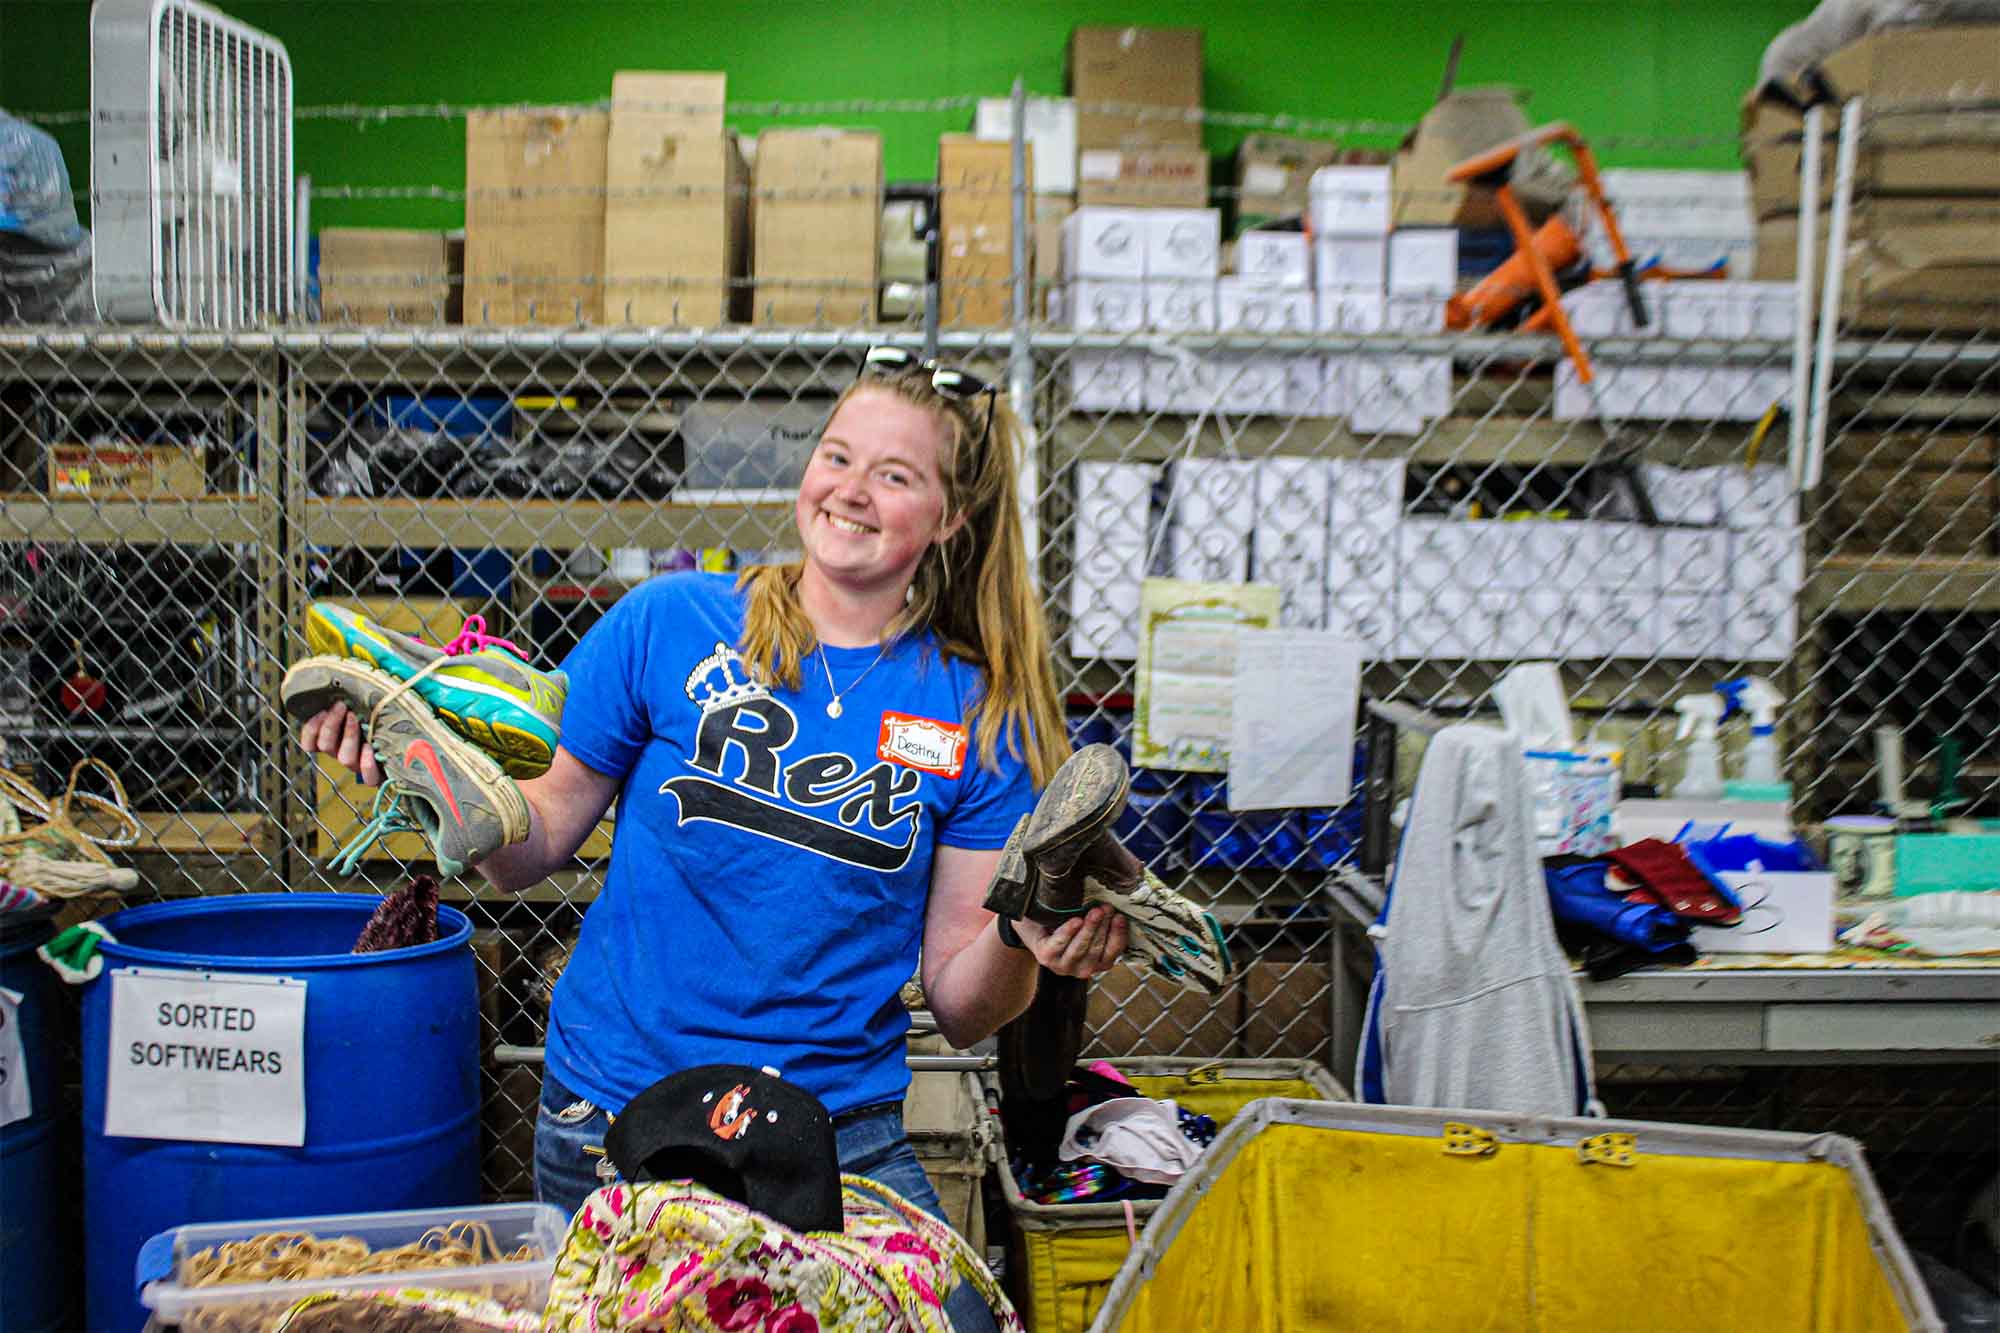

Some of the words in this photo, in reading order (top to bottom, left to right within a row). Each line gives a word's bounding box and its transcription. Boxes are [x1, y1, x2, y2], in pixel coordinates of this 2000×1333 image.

[685, 697, 920, 830] Rex
[897, 735, 941, 767] Destiny
[157, 1002, 256, 1032] SORTED
[130, 1041, 283, 1075] SOFTWEARS
